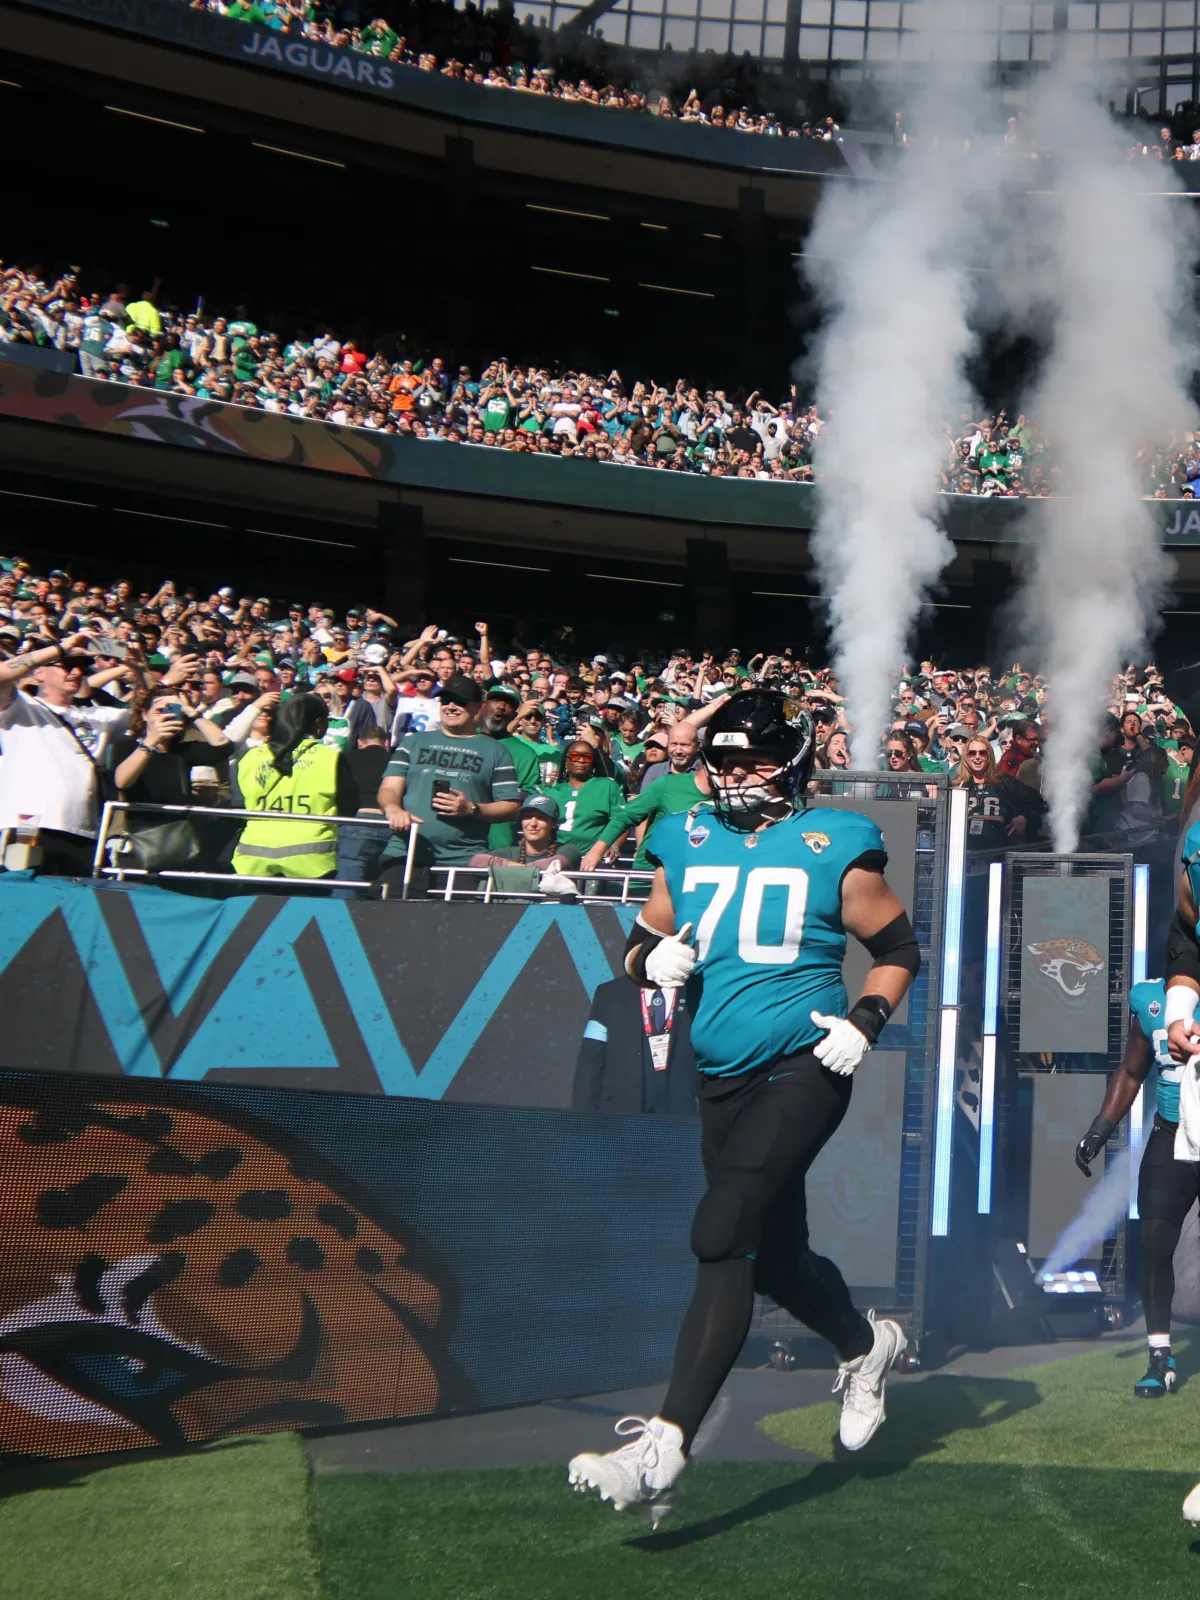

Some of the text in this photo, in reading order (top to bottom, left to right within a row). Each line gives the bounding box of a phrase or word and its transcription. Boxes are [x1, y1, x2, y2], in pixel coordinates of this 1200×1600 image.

[243, 32, 394, 89] JAGUARS
[487, 397, 507, 414] 62
[721, 733, 735, 744] JAX
[416, 747, 484, 775] EAGLES
[1172, 777, 1181, 800] 1
[559, 801, 578, 832] 1
[682, 865, 809, 965] 70
